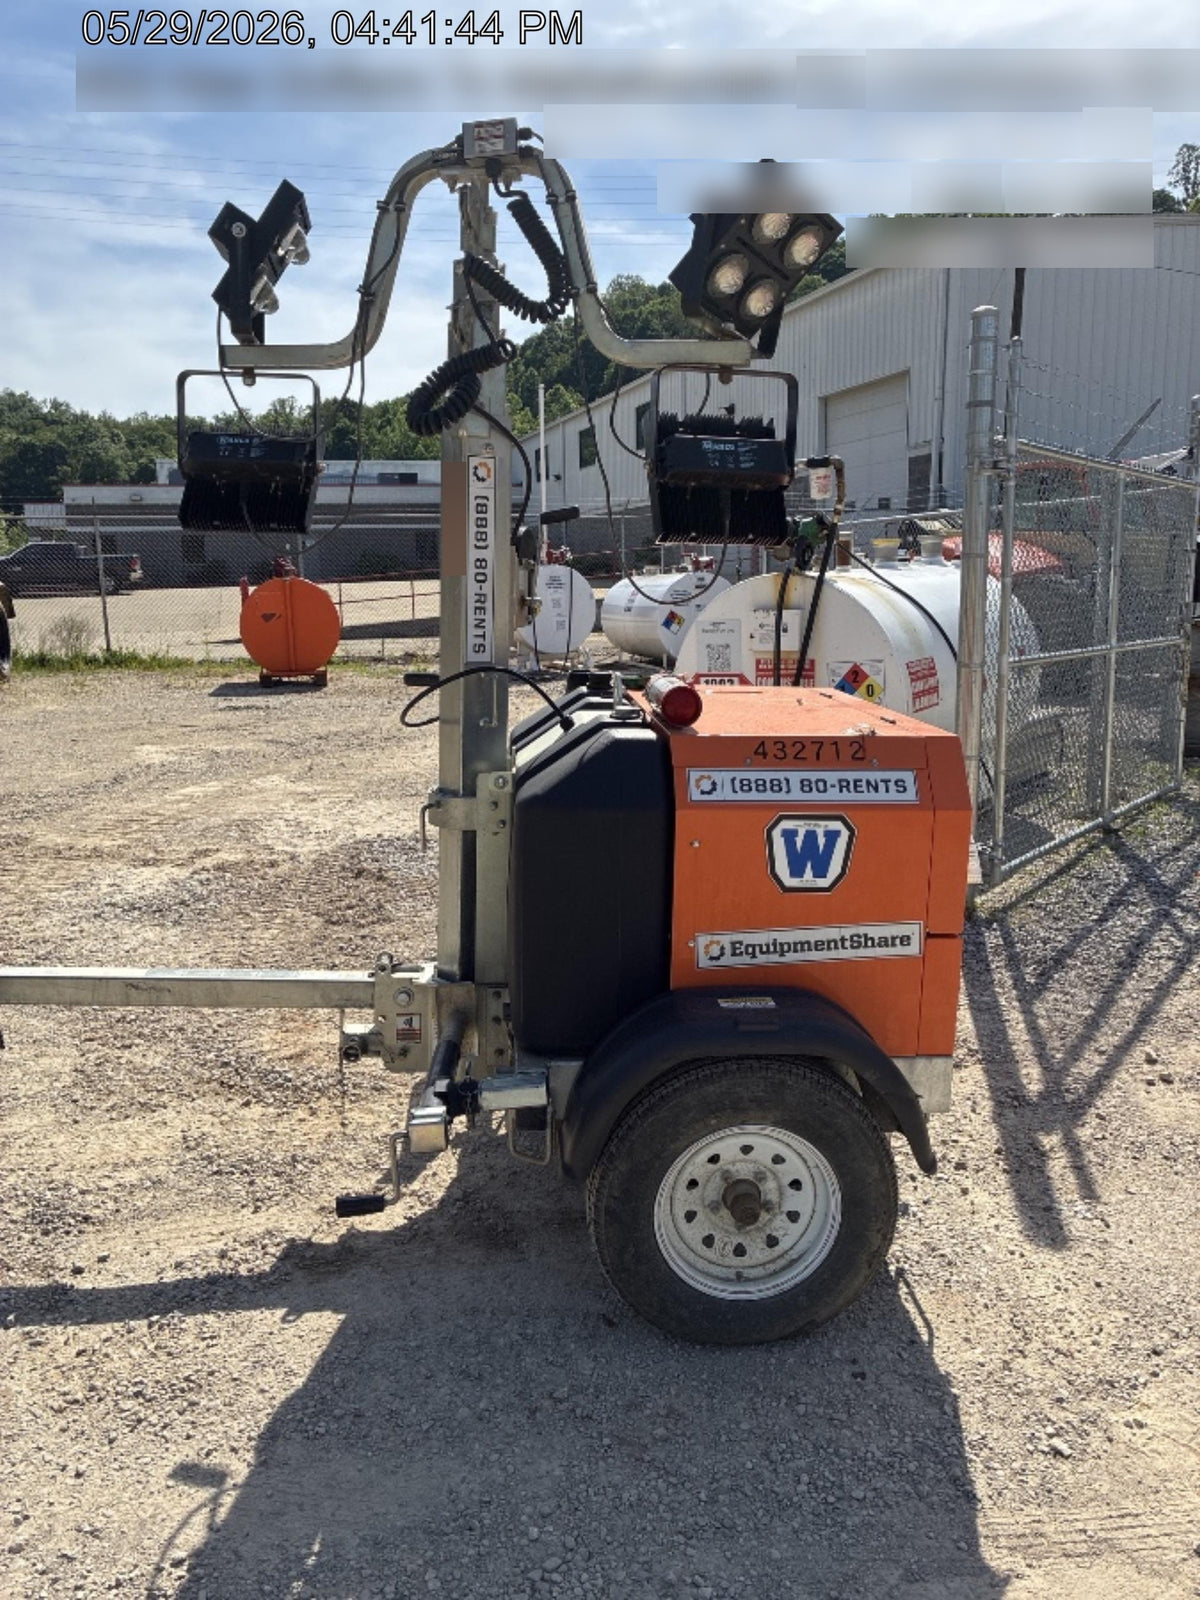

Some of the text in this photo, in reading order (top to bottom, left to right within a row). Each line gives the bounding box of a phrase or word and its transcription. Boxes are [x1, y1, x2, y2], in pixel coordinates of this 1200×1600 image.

[472, 557, 488, 654] 80-RENTS
[852, 670, 859, 683] 2
[866, 684, 874, 697] 0
[753, 740, 866, 761] 432712
[799, 777, 908, 794] 80-RENTS
[780, 828, 841, 878] W
[729, 933, 912, 958] EquipmentShare
